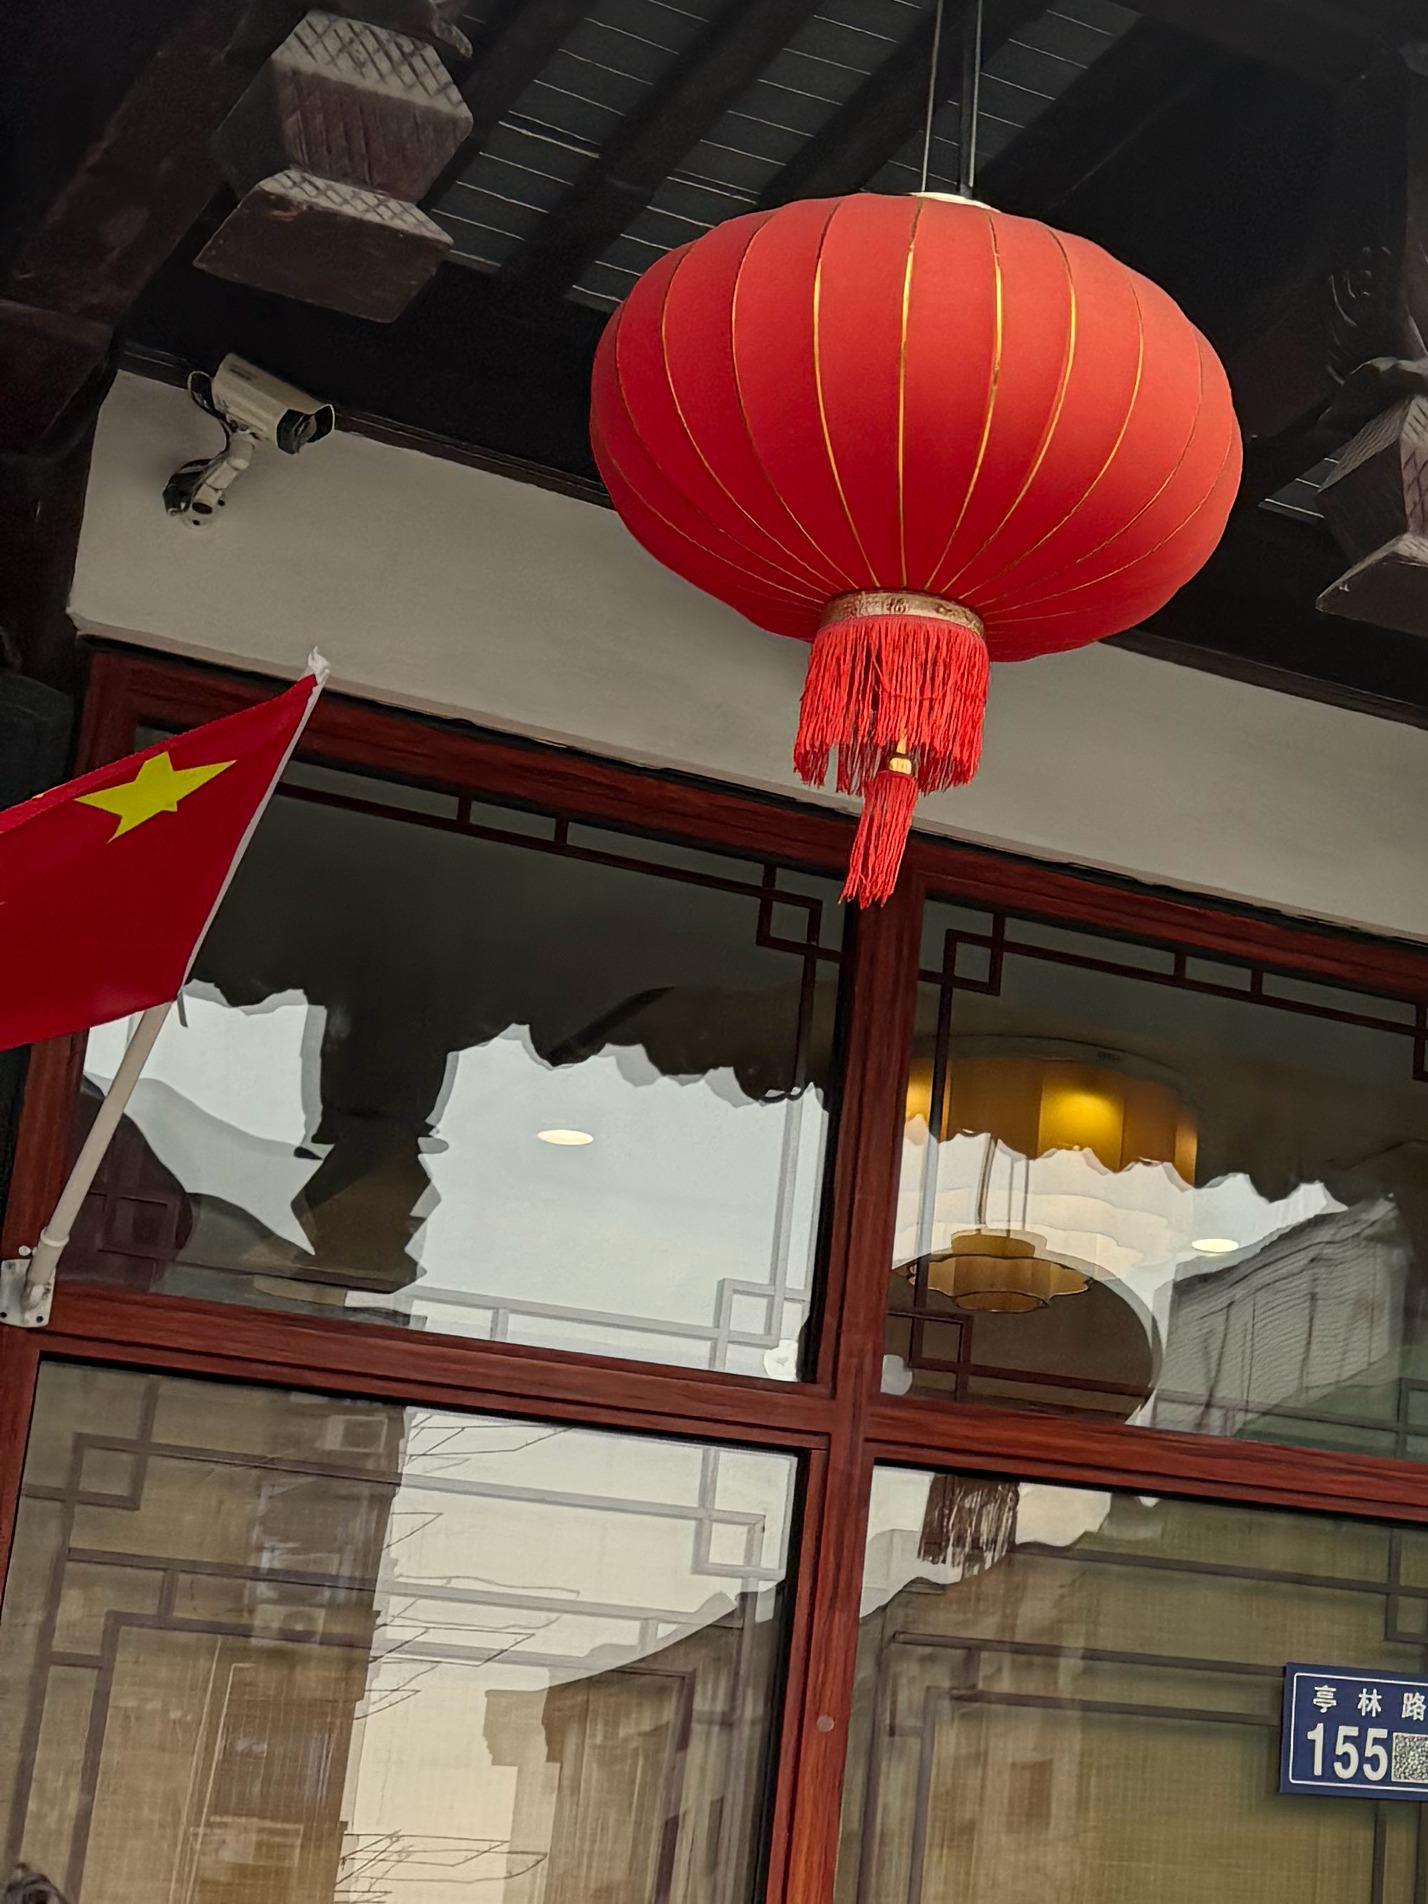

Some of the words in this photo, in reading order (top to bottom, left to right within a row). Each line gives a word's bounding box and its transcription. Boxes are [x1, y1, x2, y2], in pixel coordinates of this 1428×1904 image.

[1312, 1684, 1427, 1722] 亭林路
[1306, 1722, 1389, 1782] 155
